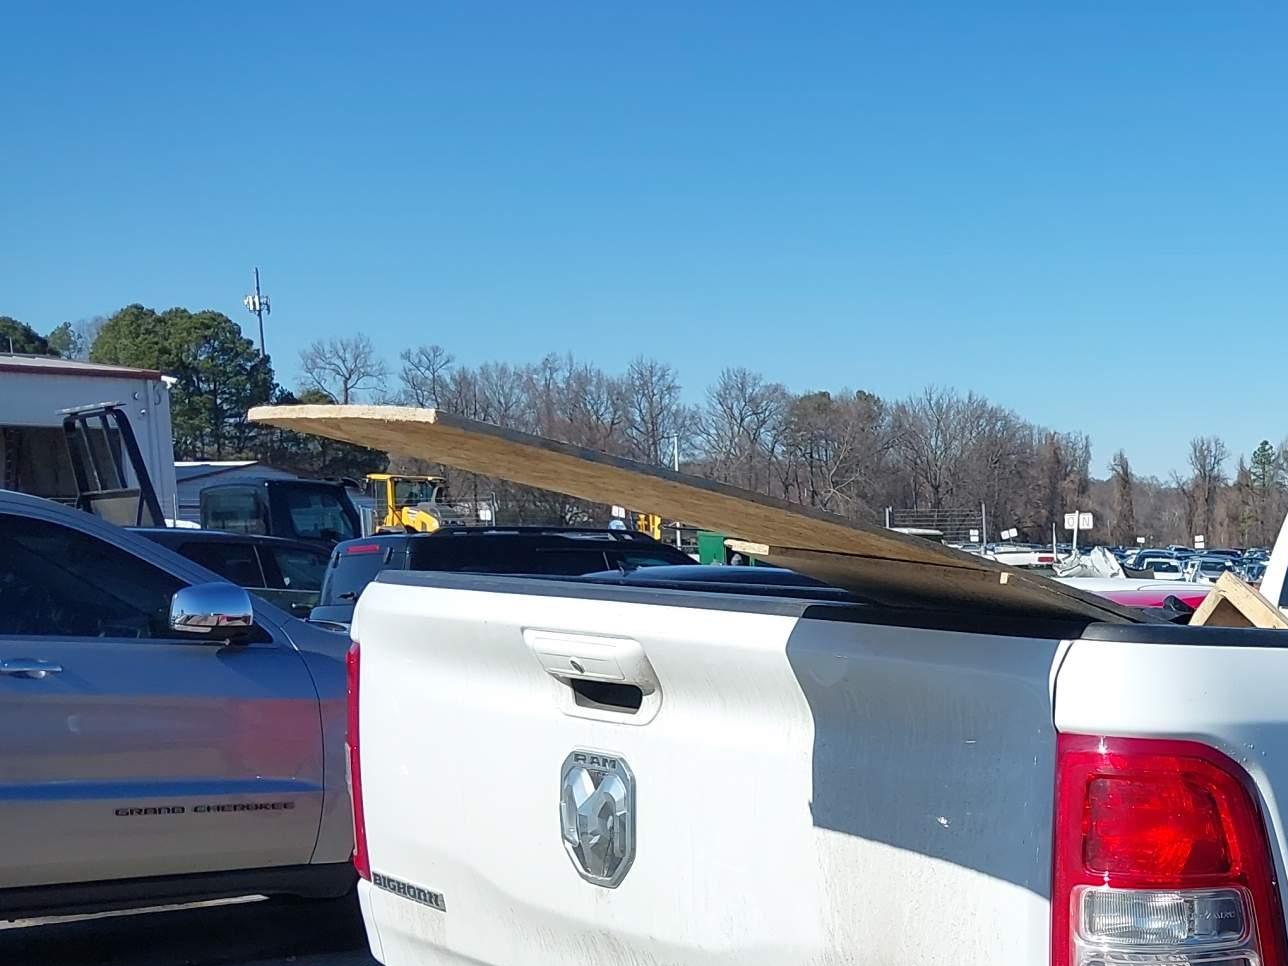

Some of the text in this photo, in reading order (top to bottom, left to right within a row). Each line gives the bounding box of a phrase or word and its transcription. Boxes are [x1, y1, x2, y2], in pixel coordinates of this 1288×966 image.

[573, 753, 617, 769] RAM
[115, 802, 295, 816] GRAND CHEROKEE
